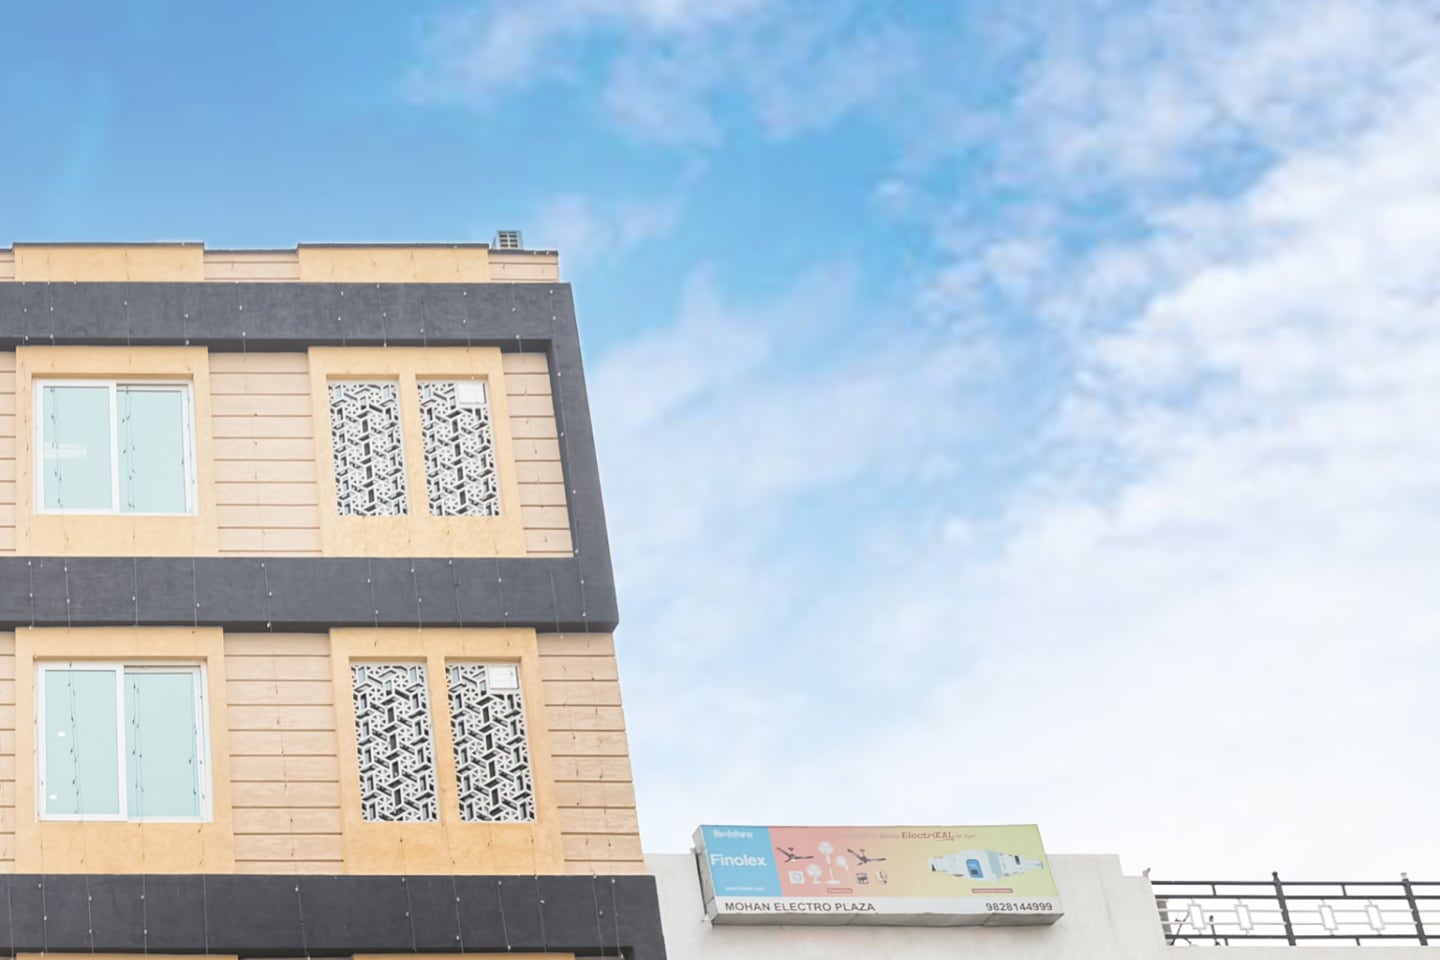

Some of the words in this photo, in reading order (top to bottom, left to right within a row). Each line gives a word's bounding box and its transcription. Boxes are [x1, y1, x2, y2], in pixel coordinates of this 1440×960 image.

[710, 853, 767, 867] Finolex
[725, 902, 770, 911] MOHAN
[774, 902, 831, 911] ELECTRO
[835, 902, 875, 911] PLAZA
[985, 902, 1053, 912] 9828144999
